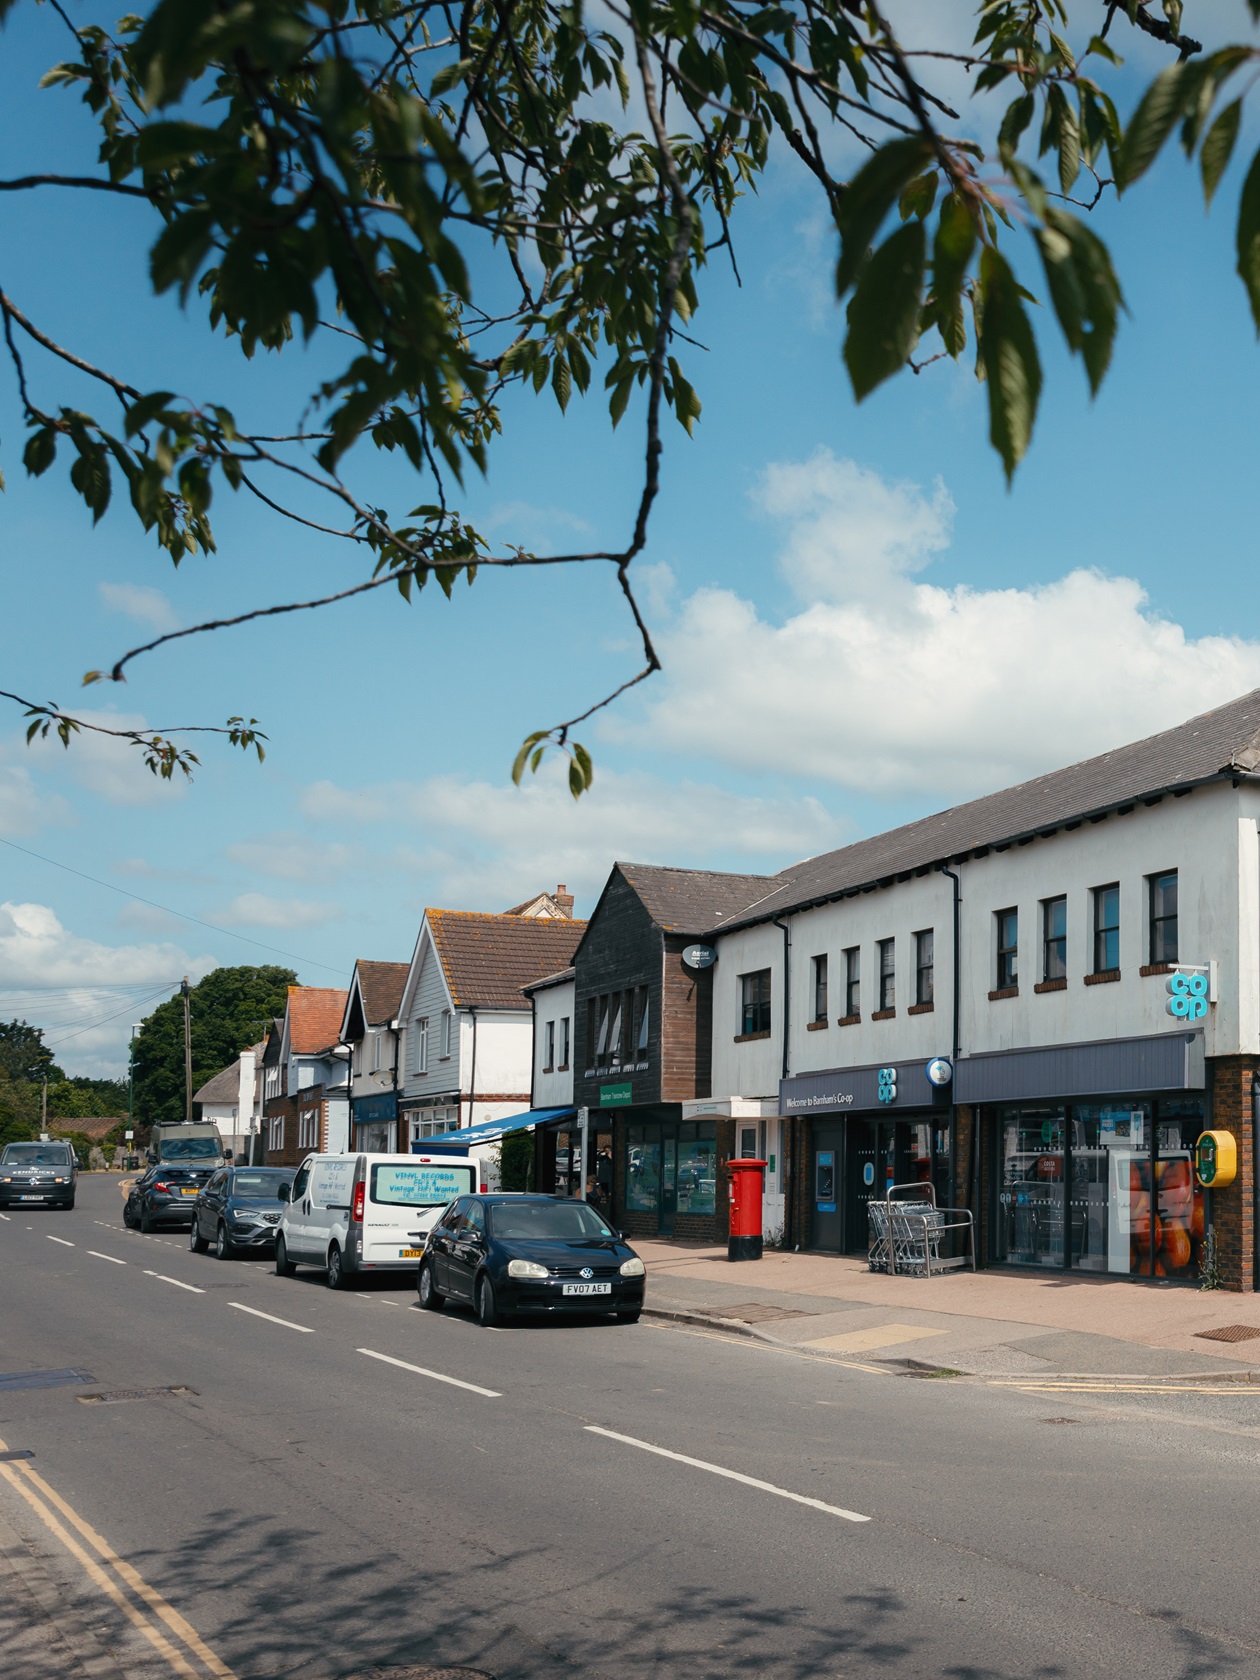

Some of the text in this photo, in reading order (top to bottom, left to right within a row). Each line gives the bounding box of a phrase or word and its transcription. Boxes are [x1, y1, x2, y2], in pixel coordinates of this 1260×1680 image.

[786, 1092, 853, 1108] Welcome to Barnham's Co-op
[421, 1173, 454, 1181] RECORDS
[389, 1185, 414, 1193] Vintage
[567, 1284, 608, 1294] FV07 AET
